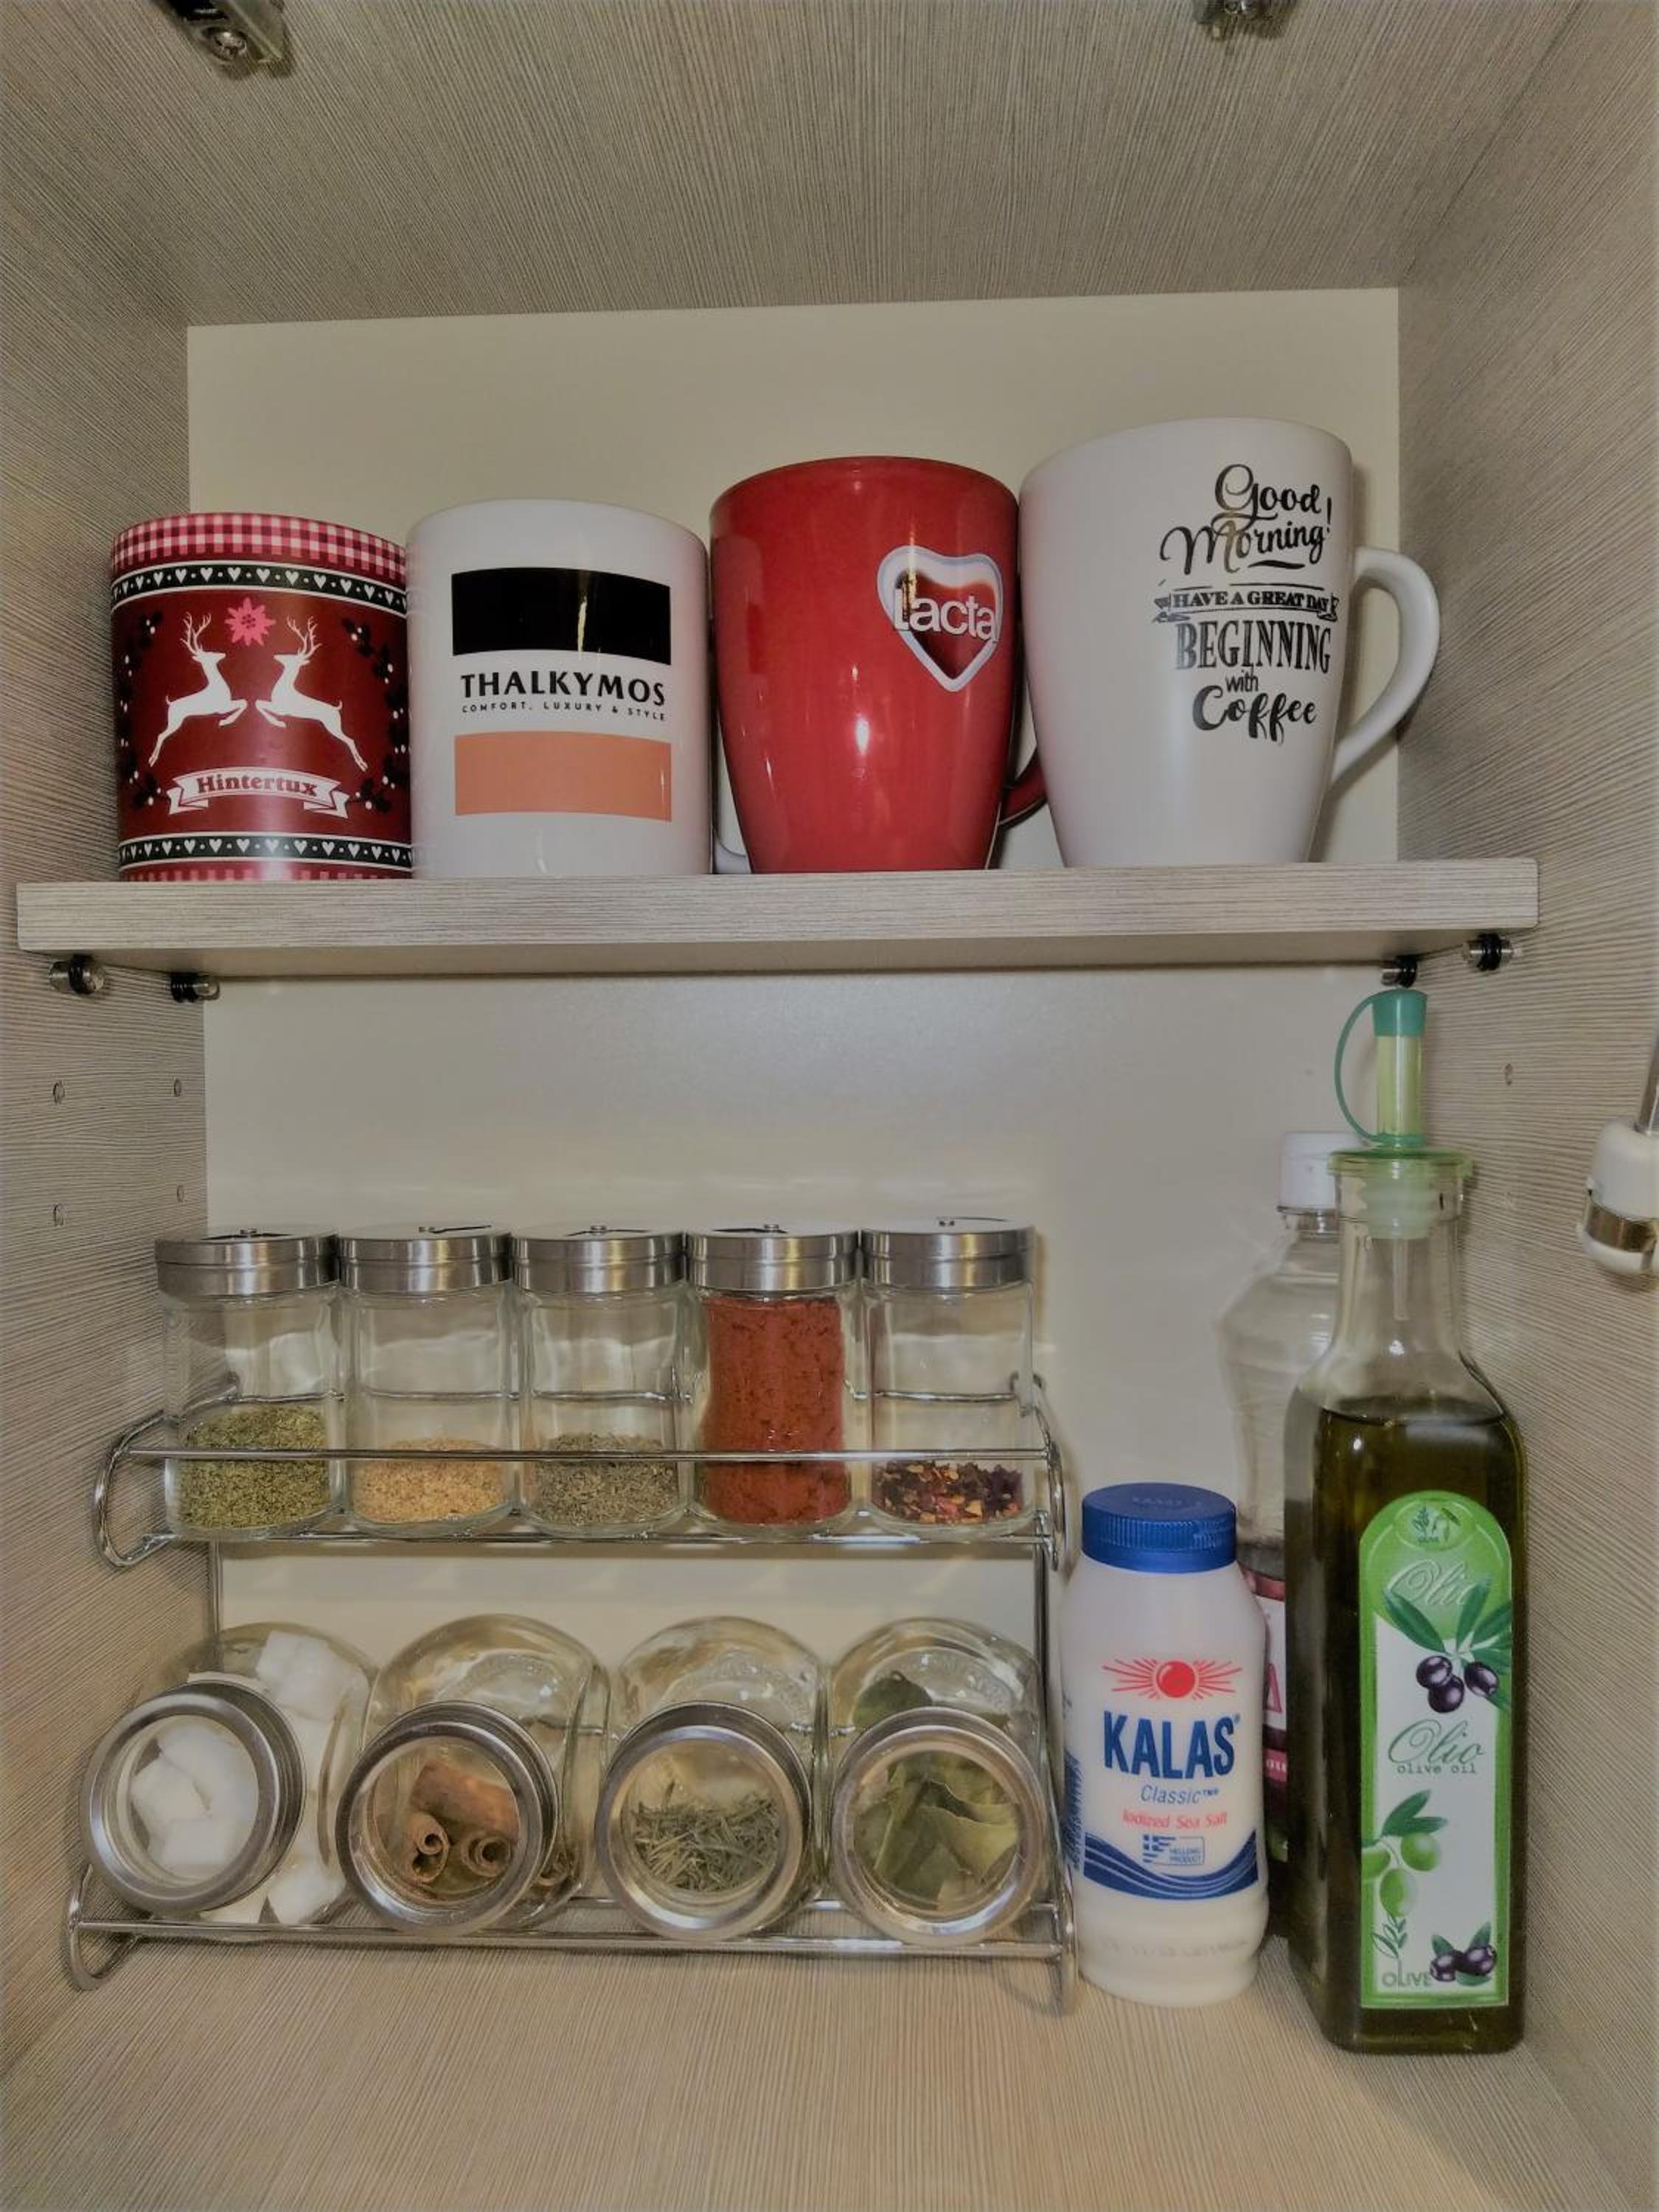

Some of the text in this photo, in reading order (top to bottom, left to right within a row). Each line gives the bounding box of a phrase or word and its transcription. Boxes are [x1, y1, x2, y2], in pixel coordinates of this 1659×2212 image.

[1211, 464, 1322, 524] Good
[894, 588, 998, 642] lacta
[1172, 591, 1329, 611] HAVE A GREAT DAY
[1175, 620, 1332, 674] BEGINNING
[461, 670, 665, 706] THALKYMOS
[1225, 669, 1259, 693] with
[543, 702, 602, 712] LUXURY
[628, 707, 665, 722] STYLE
[1192, 685, 1317, 743] Coffee
[196, 774, 318, 797] Hintertux
[1388, 1719, 1485, 1764] Olio
[1176, 1815, 1200, 1829] Sea
